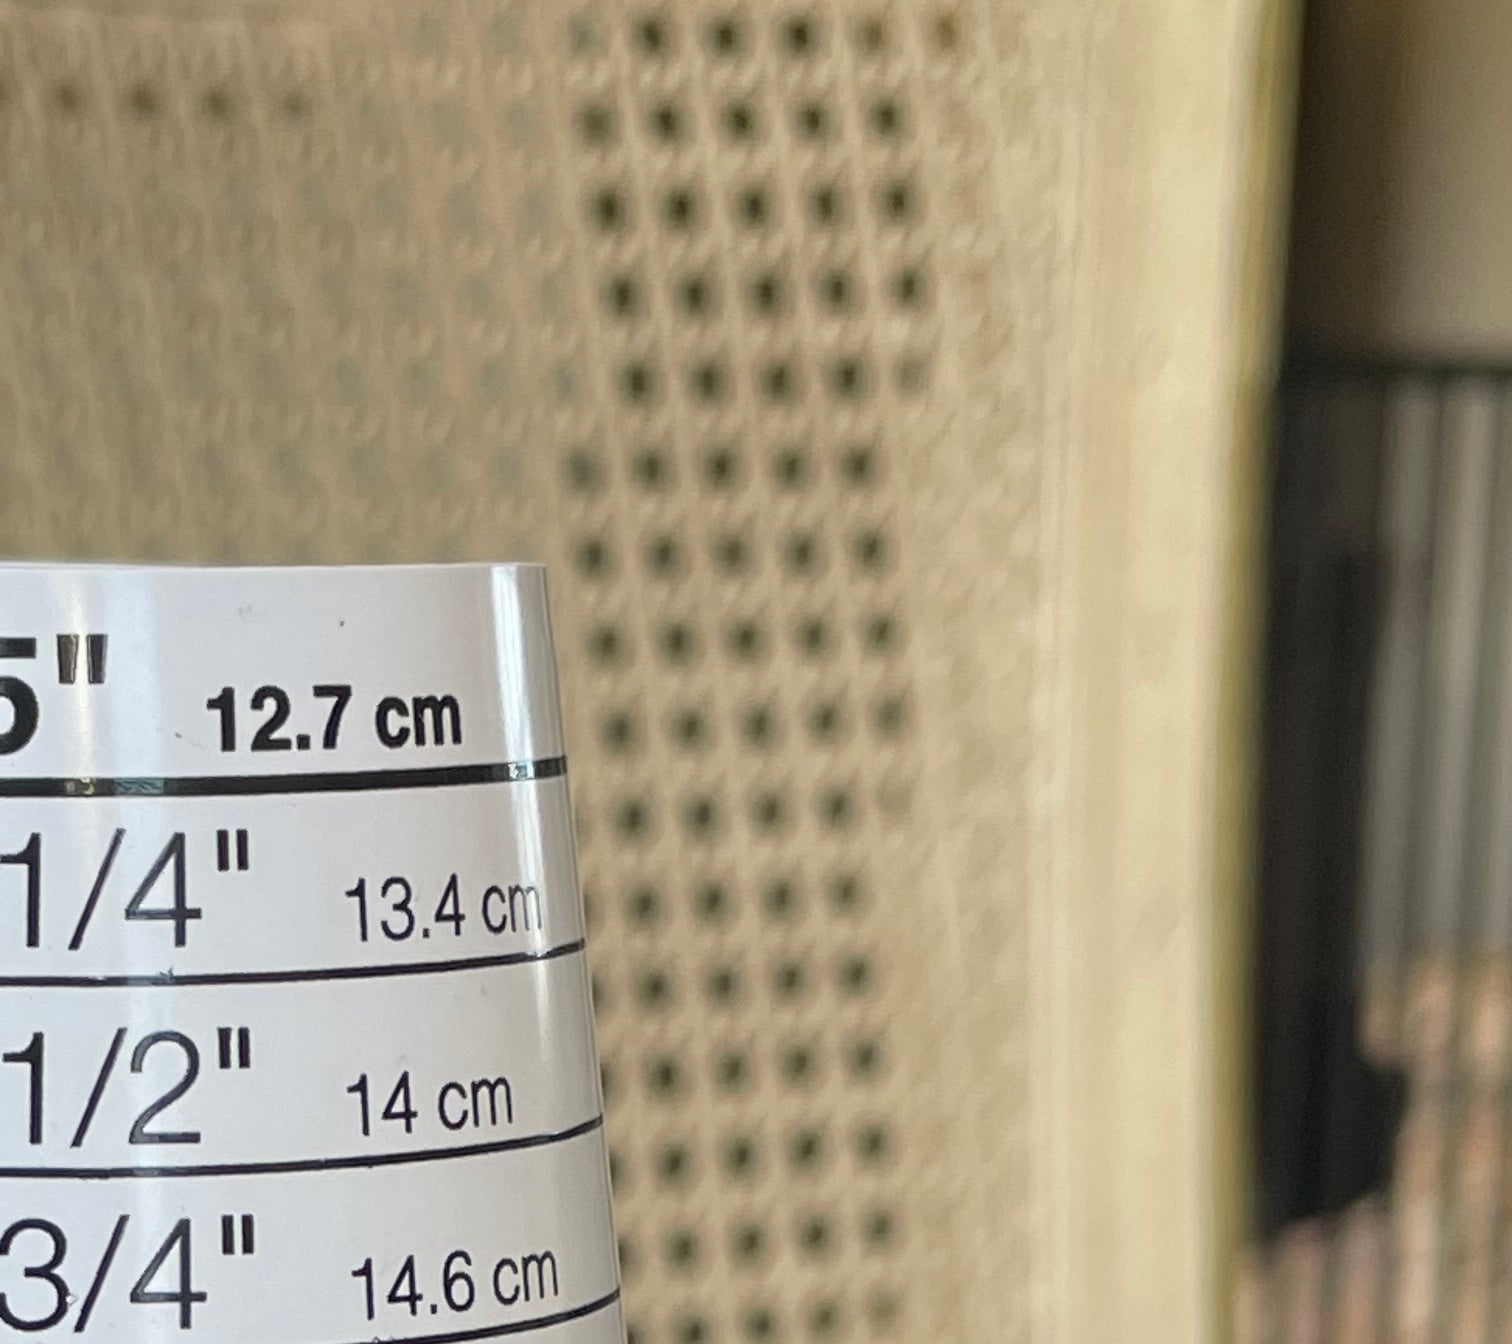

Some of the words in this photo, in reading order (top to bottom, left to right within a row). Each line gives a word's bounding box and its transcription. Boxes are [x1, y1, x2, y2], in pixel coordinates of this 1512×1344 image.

[206, 683, 353, 753] 12.7
[374, 694, 463, 749] cm
[344, 873, 466, 943] 13.4
[481, 877, 544, 936] cm
[1, 1026, 251, 1149] 1/2"
[346, 1070, 419, 1137] 14
[437, 1076, 513, 1131] cm
[350, 1249, 475, 1321] 14.6
[492, 1250, 559, 1306] cm
